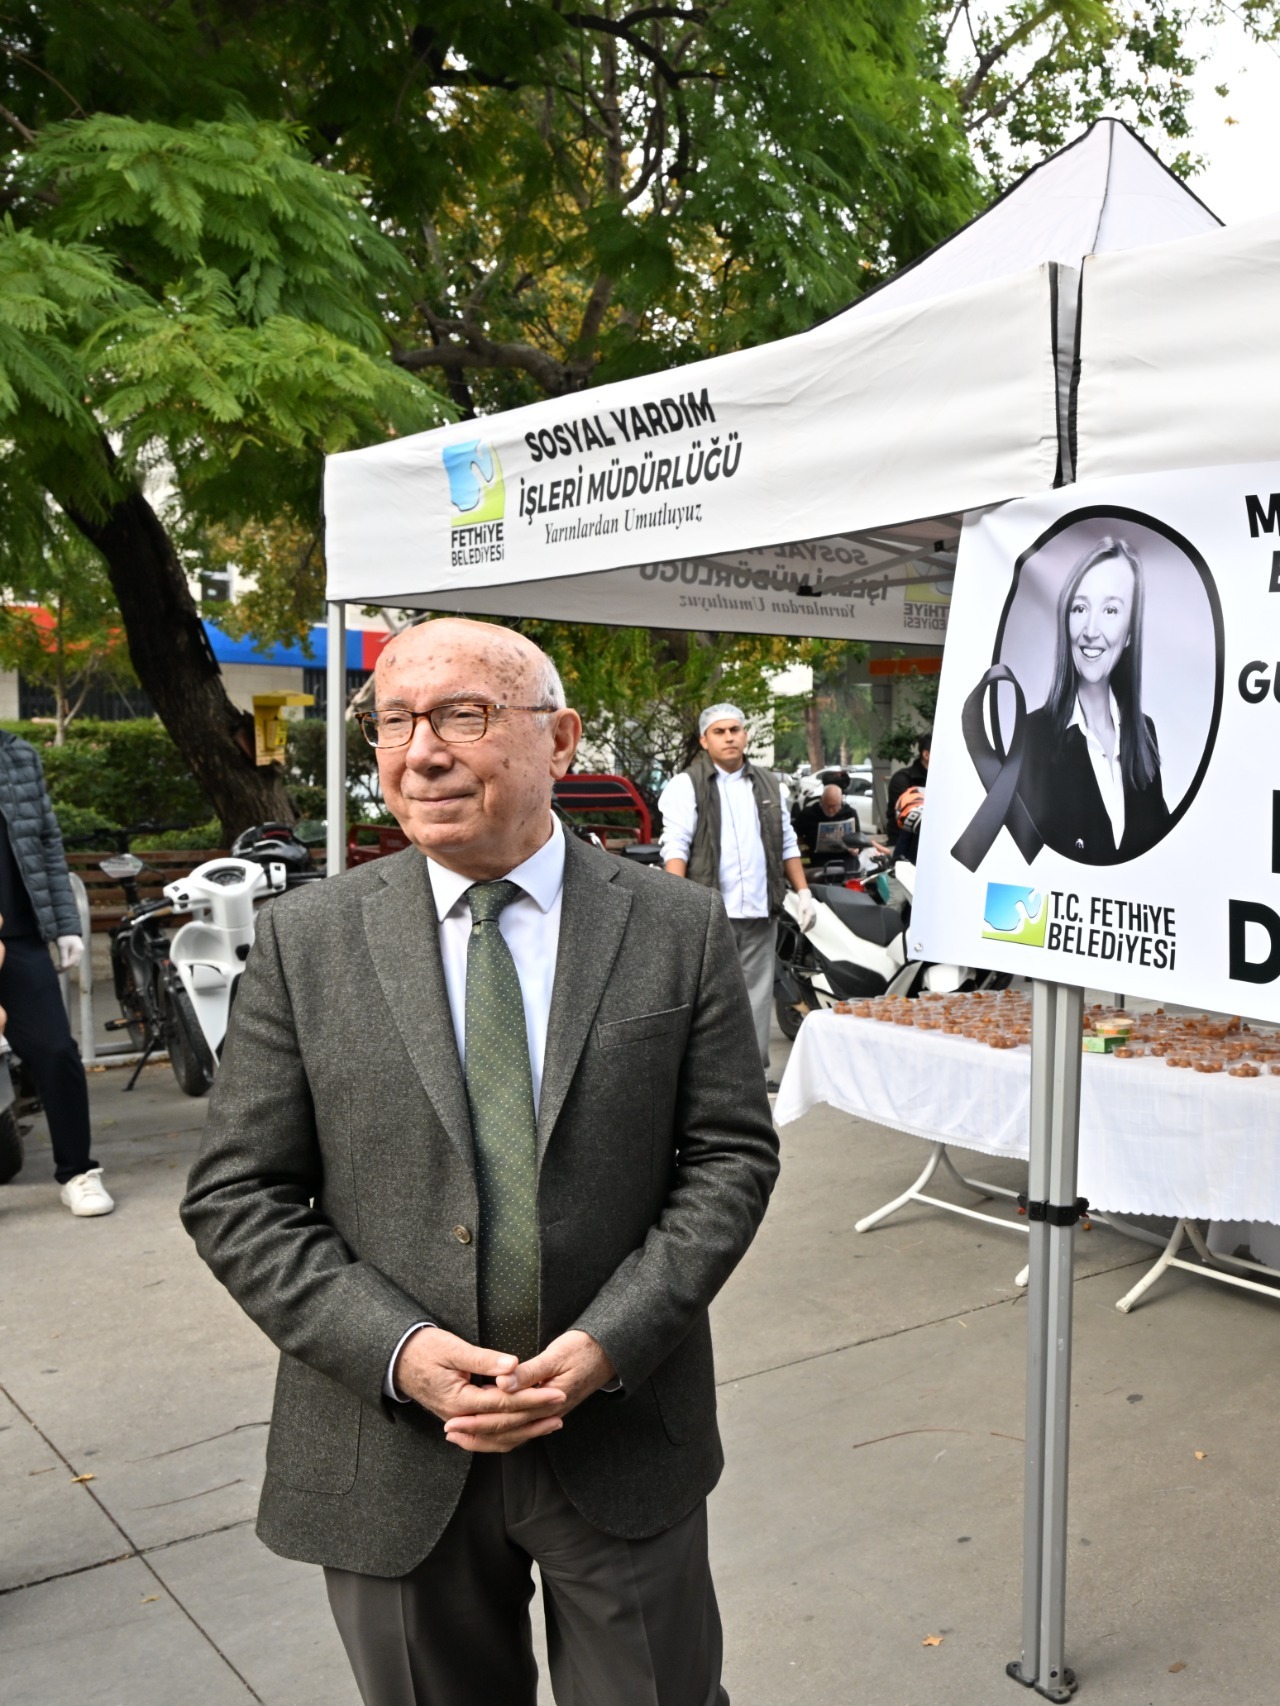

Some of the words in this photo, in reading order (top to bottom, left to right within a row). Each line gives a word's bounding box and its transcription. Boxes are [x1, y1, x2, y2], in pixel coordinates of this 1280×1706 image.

[524, 415, 616, 462] SOSYAL
[610, 388, 716, 443] YARDIM
[519, 464, 583, 525] İŞLERİ
[587, 432, 742, 504] MÜDÜRLÜĞÜ
[545, 514, 619, 544] Yarınlardan
[624, 502, 703, 532] Umutluyuz
[1051, 891, 1083, 923] T.C.
